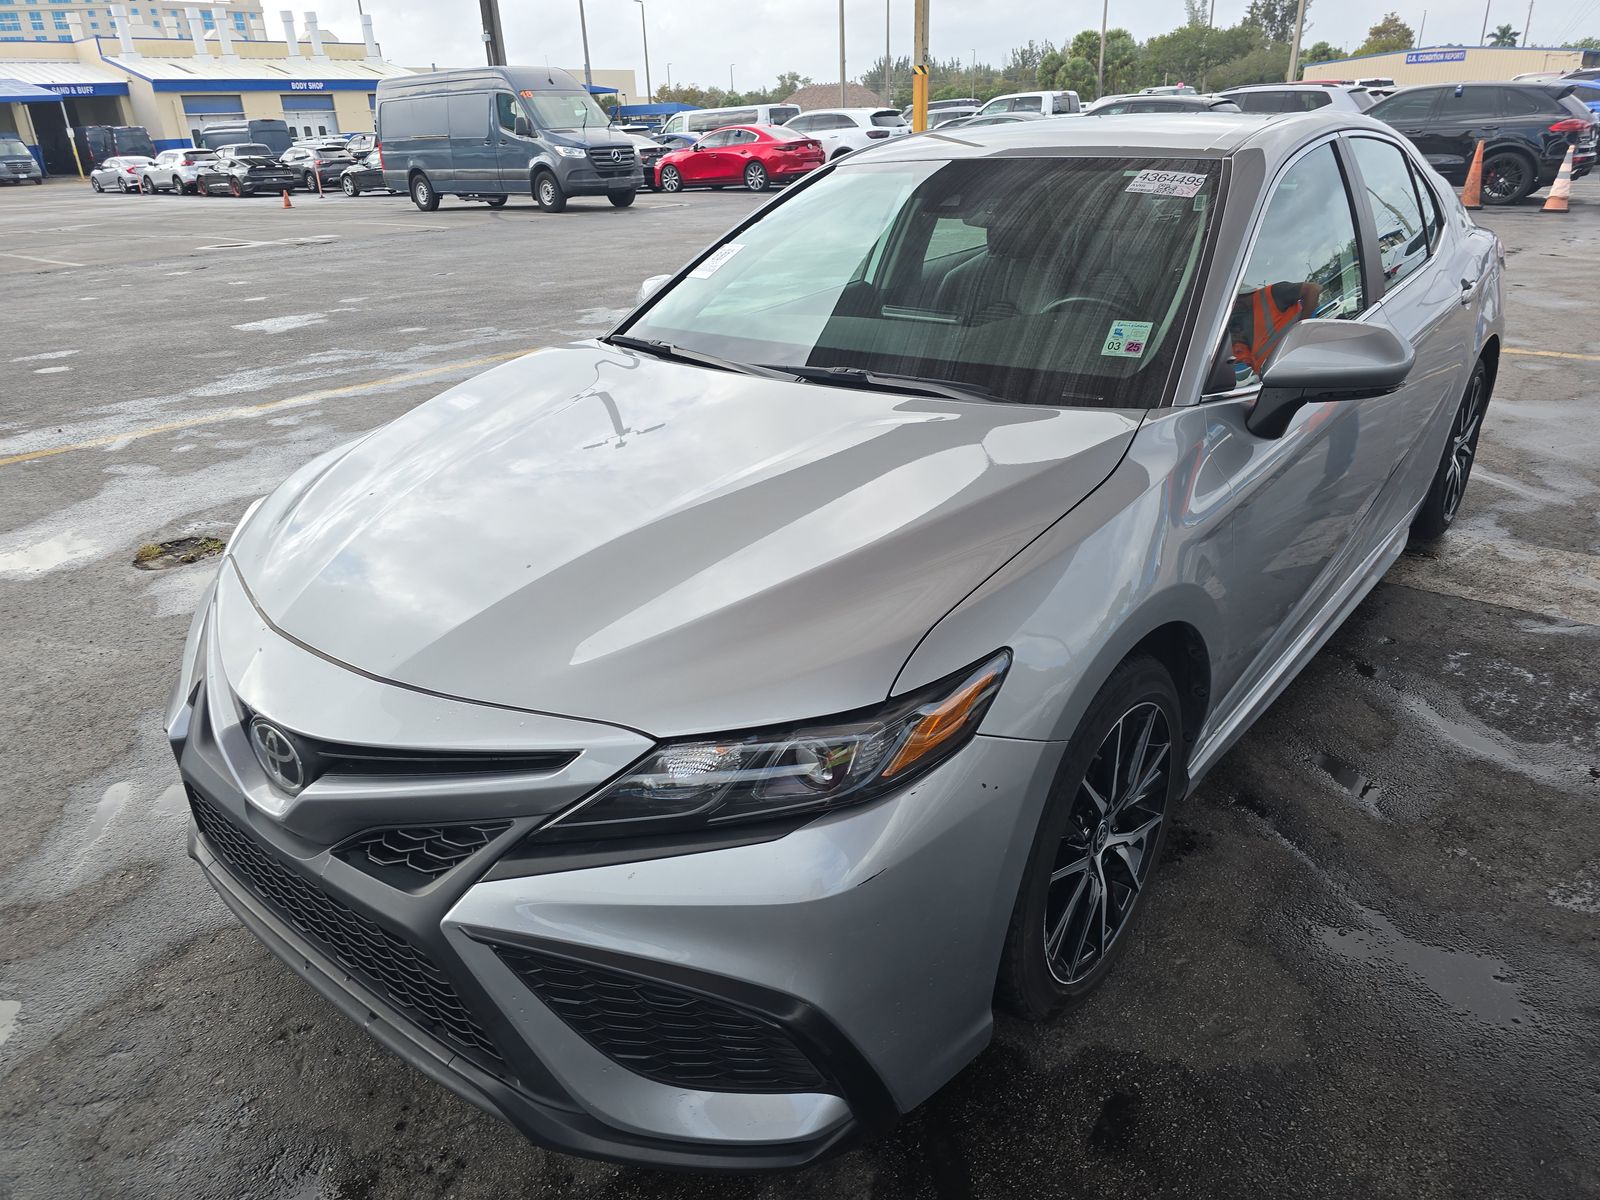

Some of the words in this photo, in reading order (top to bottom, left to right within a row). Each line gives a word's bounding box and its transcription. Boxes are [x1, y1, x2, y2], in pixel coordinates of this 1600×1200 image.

[51, 86, 70, 94] SAND
[71, 86, 76, 94] &
[78, 86, 94, 94] BUFF
[291, 82, 307, 90] BODY
[308, 82, 323, 90] SHOP
[1139, 172, 1206, 187] 4364499
[1107, 341, 1121, 351] 03
[1126, 342, 1141, 352] 25
